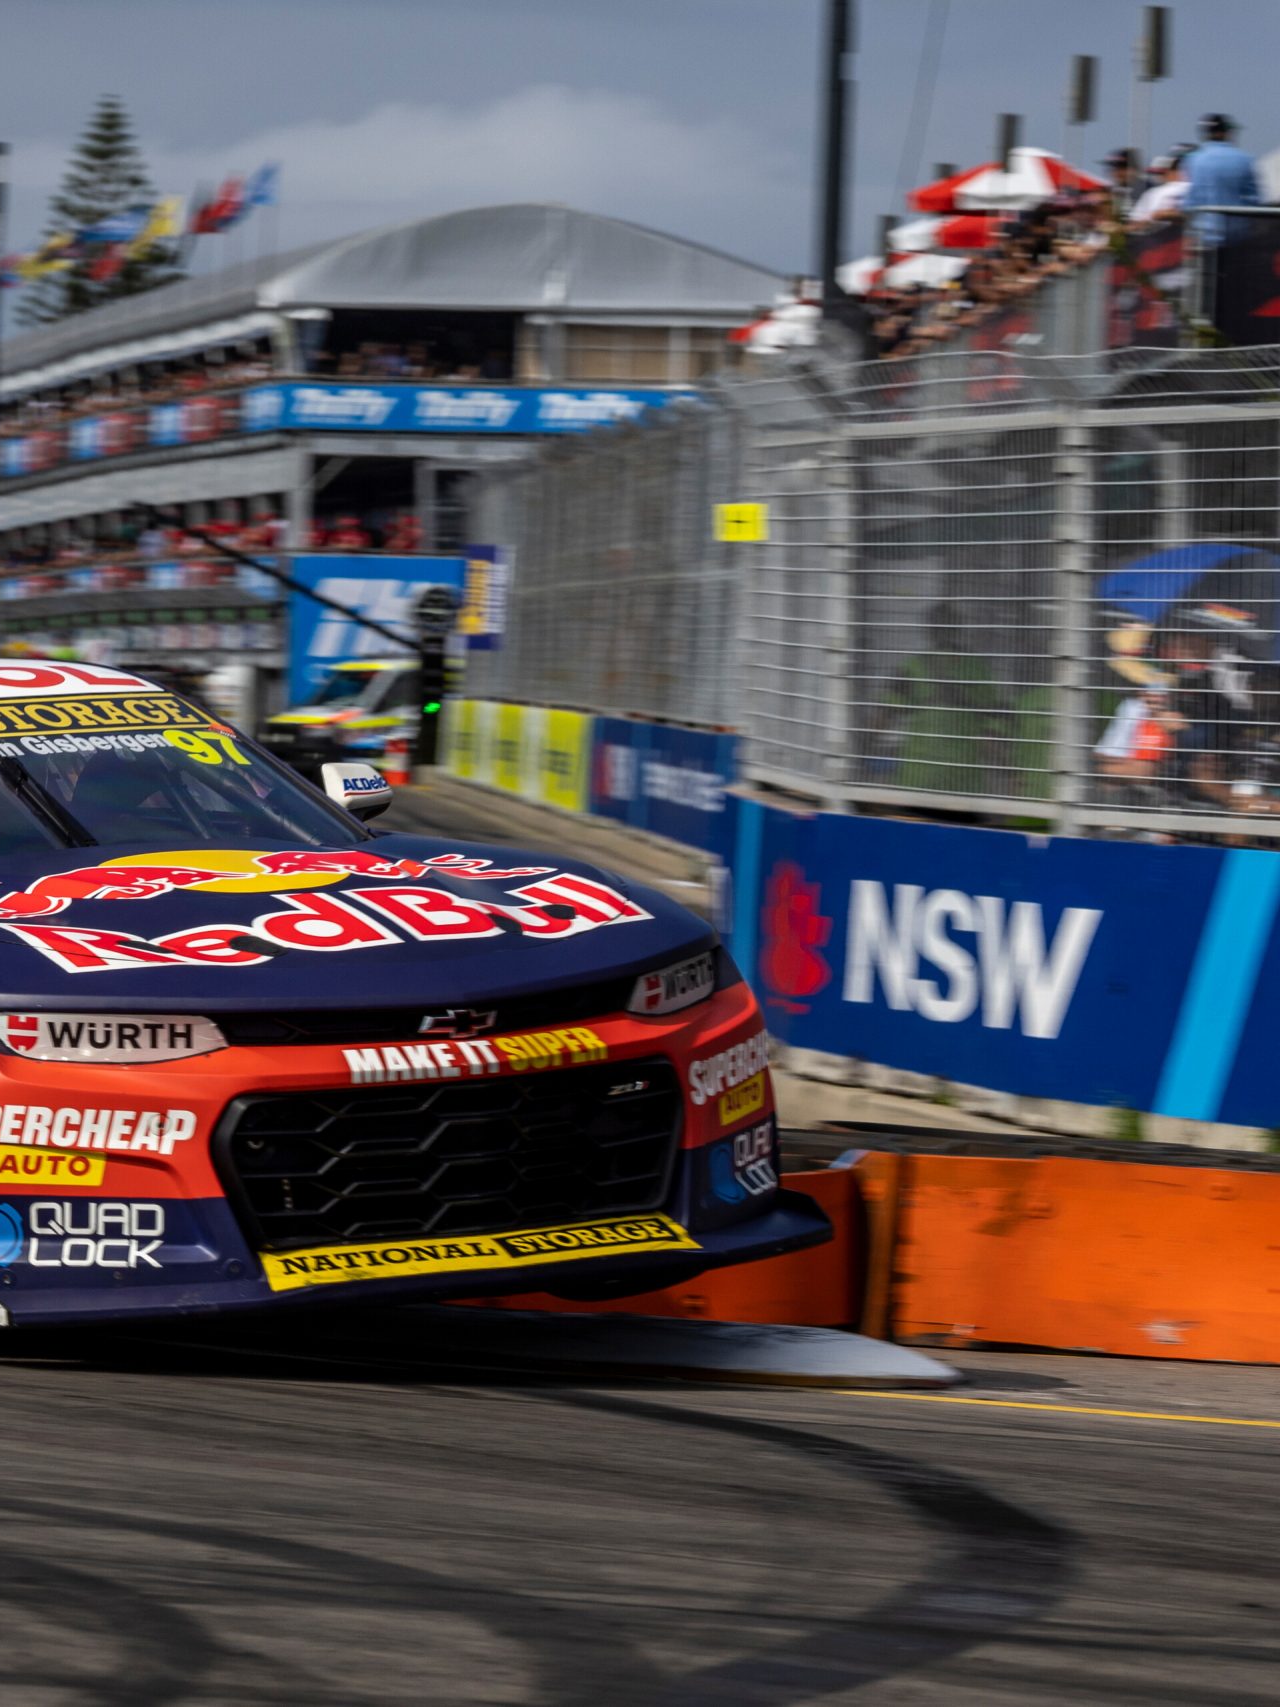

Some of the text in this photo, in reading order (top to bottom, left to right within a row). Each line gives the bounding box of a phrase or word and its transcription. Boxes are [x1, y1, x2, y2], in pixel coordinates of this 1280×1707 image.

[20, 732, 174, 756] Gisbergen
[162, 729, 252, 765] 97
[841, 879, 1105, 1040] NSW
[47, 1020, 194, 1050] WÜRTH
[342, 1026, 609, 1085] MAKE IT SUPER
[28, 1202, 165, 1237] QUAD
[28, 1238, 165, 1269] LOCK
[282, 1219, 670, 1276] NATIONAL STORAGE
